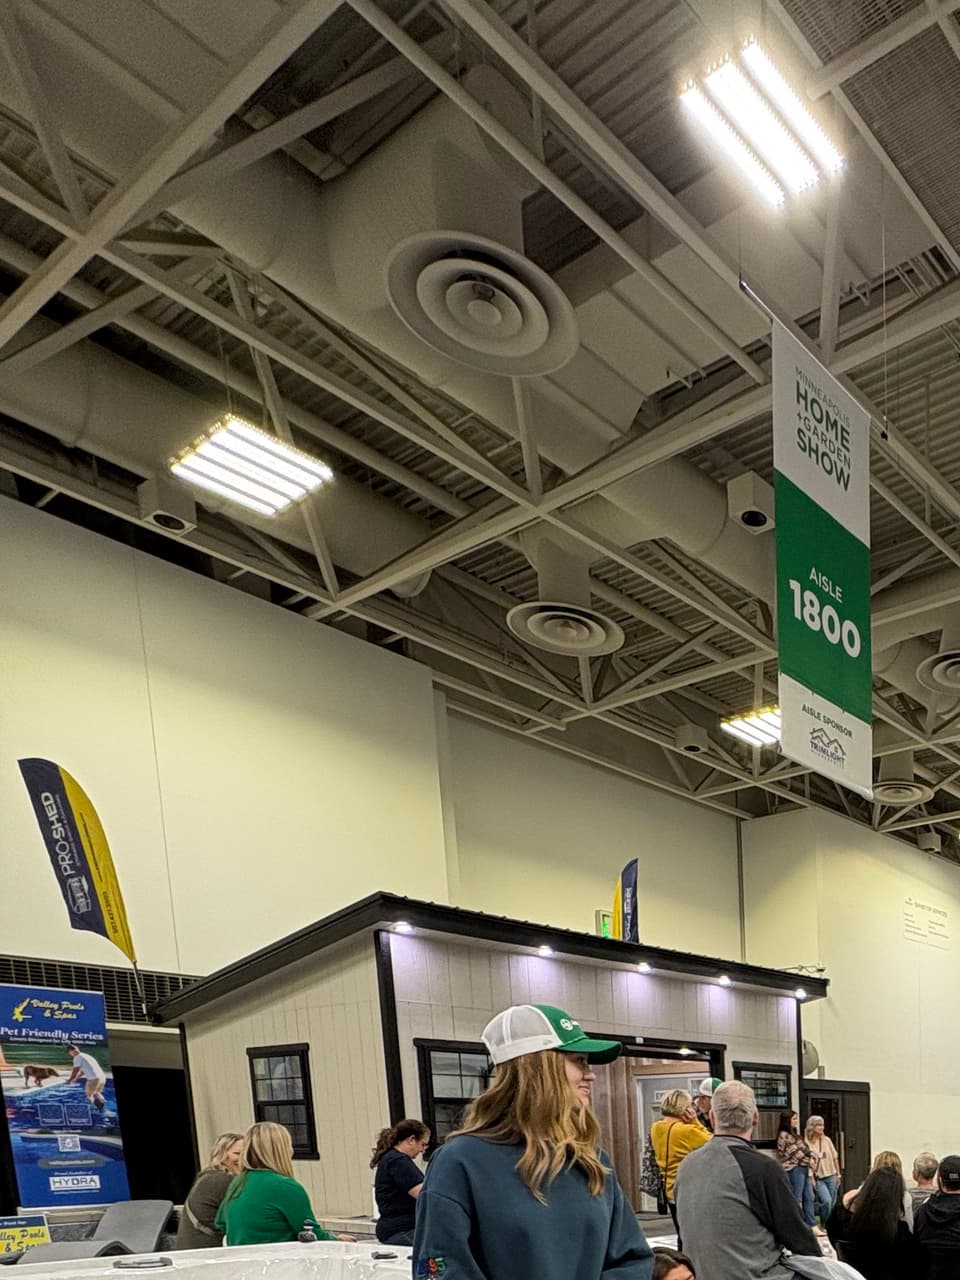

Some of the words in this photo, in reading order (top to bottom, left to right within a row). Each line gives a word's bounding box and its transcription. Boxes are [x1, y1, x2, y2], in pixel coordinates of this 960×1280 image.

[796, 380, 850, 453] HOME
[797, 428, 850, 492] SHOW
[809, 567, 843, 604] AISLE
[789, 578, 861, 659] 1800
[802, 704, 821, 721] AISLE
[822, 715, 852, 739] SPONSOR
[41, 791, 75, 876] PRO-SHED
[30, 999, 59, 1010] Valley
[61, 1001, 85, 1010] Pools
[0, 1027, 18, 1036] Pet
[21, 1028, 69, 1040] Friendly
[70, 1031, 104, 1041] Series
[52, 1177, 98, 1187] HYDRA
